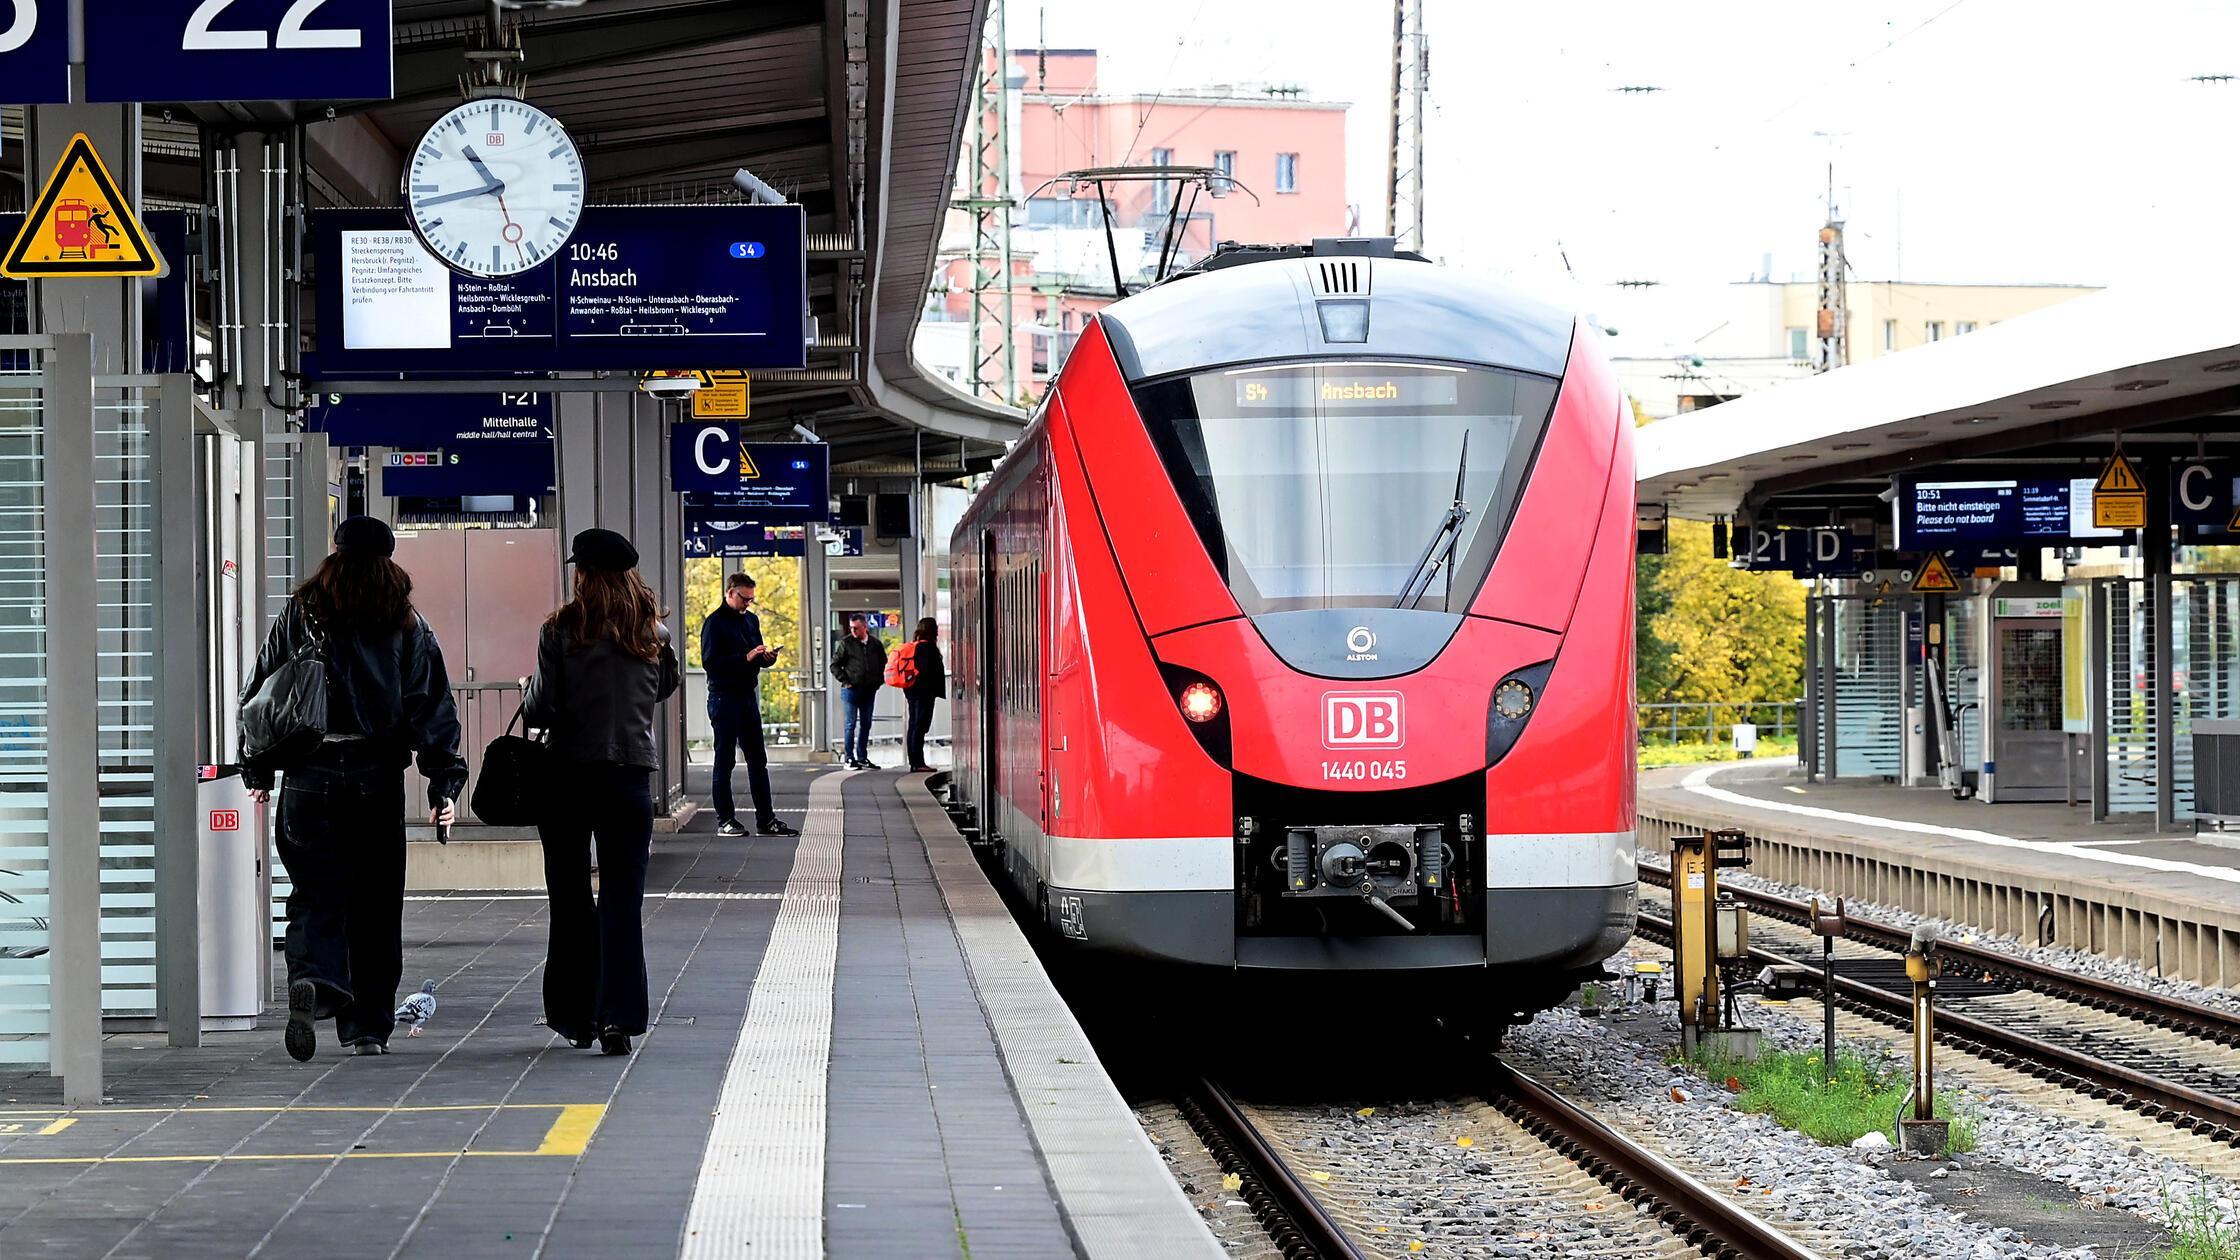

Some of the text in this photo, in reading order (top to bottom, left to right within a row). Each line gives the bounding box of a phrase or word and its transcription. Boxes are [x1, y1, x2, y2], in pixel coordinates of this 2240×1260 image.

[488, 134, 502, 145] DB
[351, 236, 368, 245] RE30
[570, 243, 618, 261] 10:46
[739, 244, 755, 256] S4
[397, 276, 413, 284] Bitte
[570, 268, 637, 287] Ansbach
[458, 283, 482, 292] N-Stein
[458, 294, 494, 303] Heilsbronn
[499, 293, 546, 304] Wicklesgreuth
[570, 295, 612, 304] N-Schweinau
[618, 295, 642, 304] N-Stein
[648, 295, 689, 304] Unterasbach
[695, 294, 734, 303] Oberasbach
[458, 304, 486, 313] Ansbach
[492, 304, 522, 313] Dombühl
[570, 306, 604, 315] Anwanden
[610, 305, 633, 314] Roßtal
[638, 305, 674, 314] Heilsbronn
[680, 305, 727, 316] Wicklesgreuth
[1245, 381, 1397, 400] S4 Ansbach
[330, 392, 341, 405] S
[482, 416, 538, 428] Mittelhalle
[456, 430, 538, 439] middle hall/hall central
[694, 426, 731, 475] C
[392, 455, 400, 465] U
[450, 454, 459, 465] S
[2179, 465, 2214, 511] C
[1916, 489, 1941, 500] 10:51
[1916, 501, 2001, 513] Bitte nicht einsteigen
[1916, 513, 1995, 525] Please do not board
[1757, 530, 1787, 562] 21
[1816, 530, 1840, 562] D
[1331, 700, 1397, 741] DB
[1321, 760, 1407, 780] 1440 045
[212, 812, 237, 829] DB
